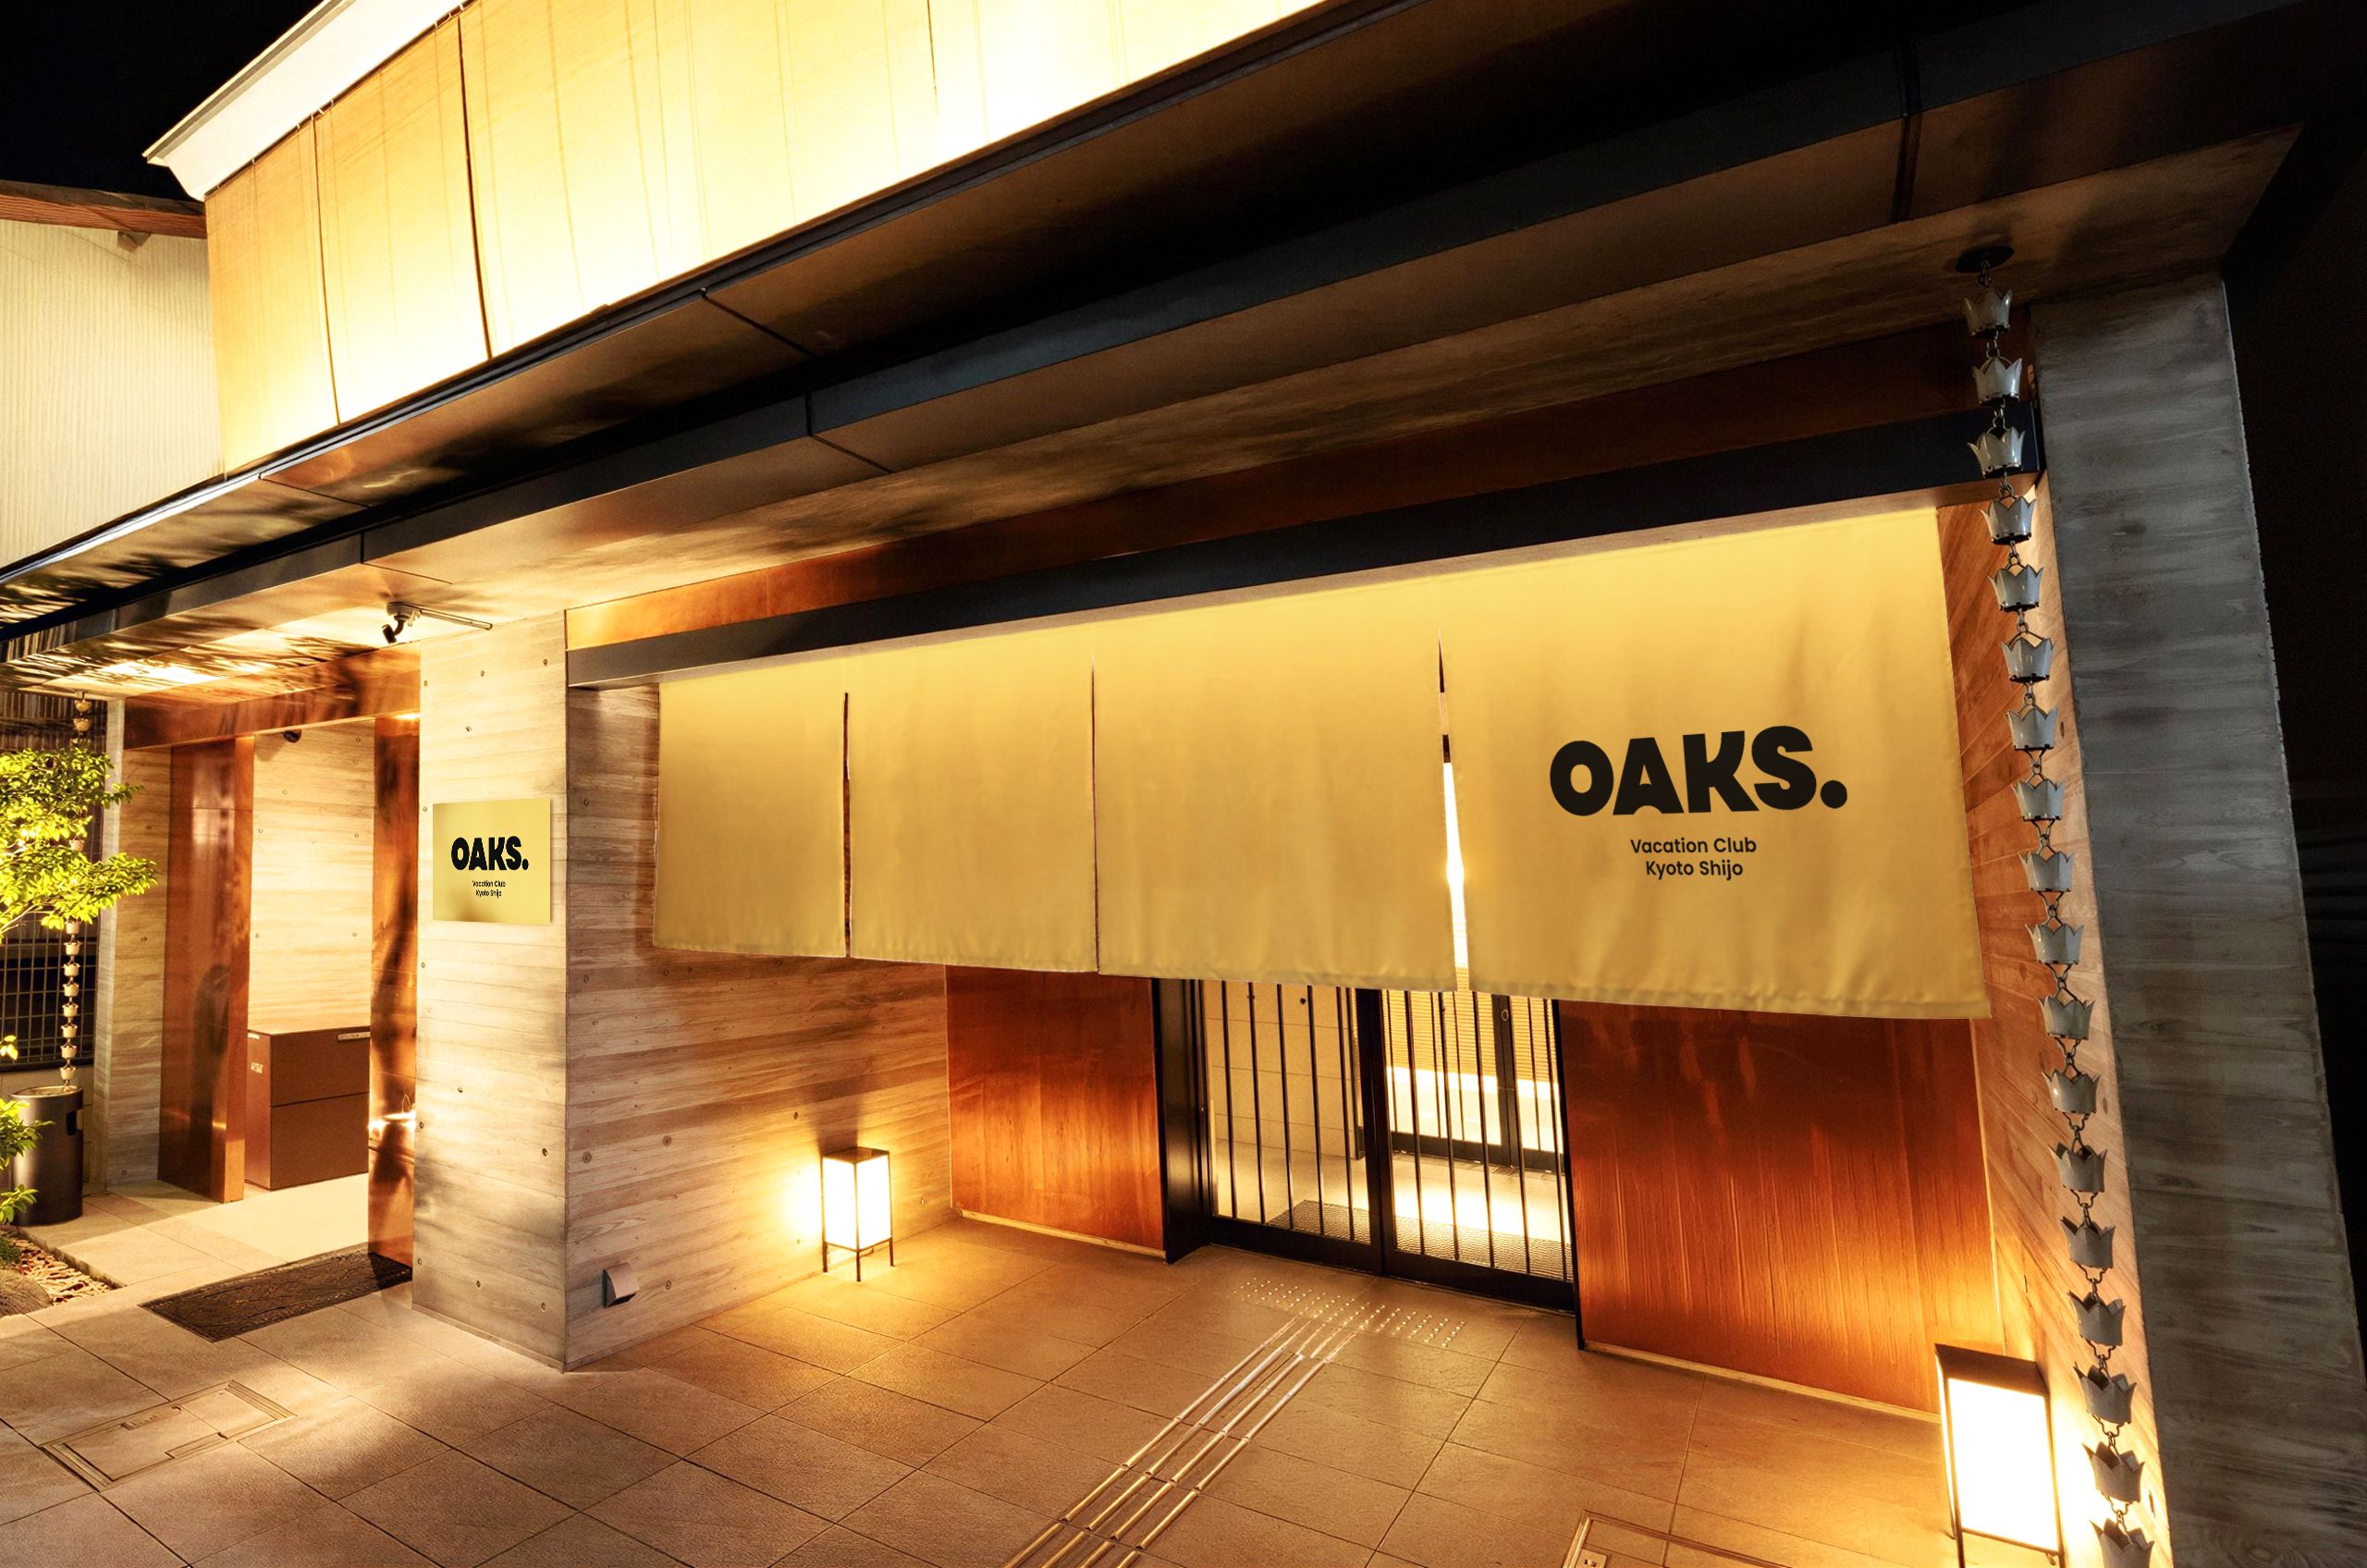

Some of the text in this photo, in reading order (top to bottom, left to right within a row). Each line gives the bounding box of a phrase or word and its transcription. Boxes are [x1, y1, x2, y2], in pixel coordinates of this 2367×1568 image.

[1549, 725, 1848, 817] OAKS.
[451, 836, 530, 871] OAKS.
[1630, 837, 1758, 854] Vacation Club
[1645, 860, 1744, 882] Kyoto Shijo
[472, 879, 494, 888] Vacation
[475, 889, 502, 899] Kyoto Shijo
